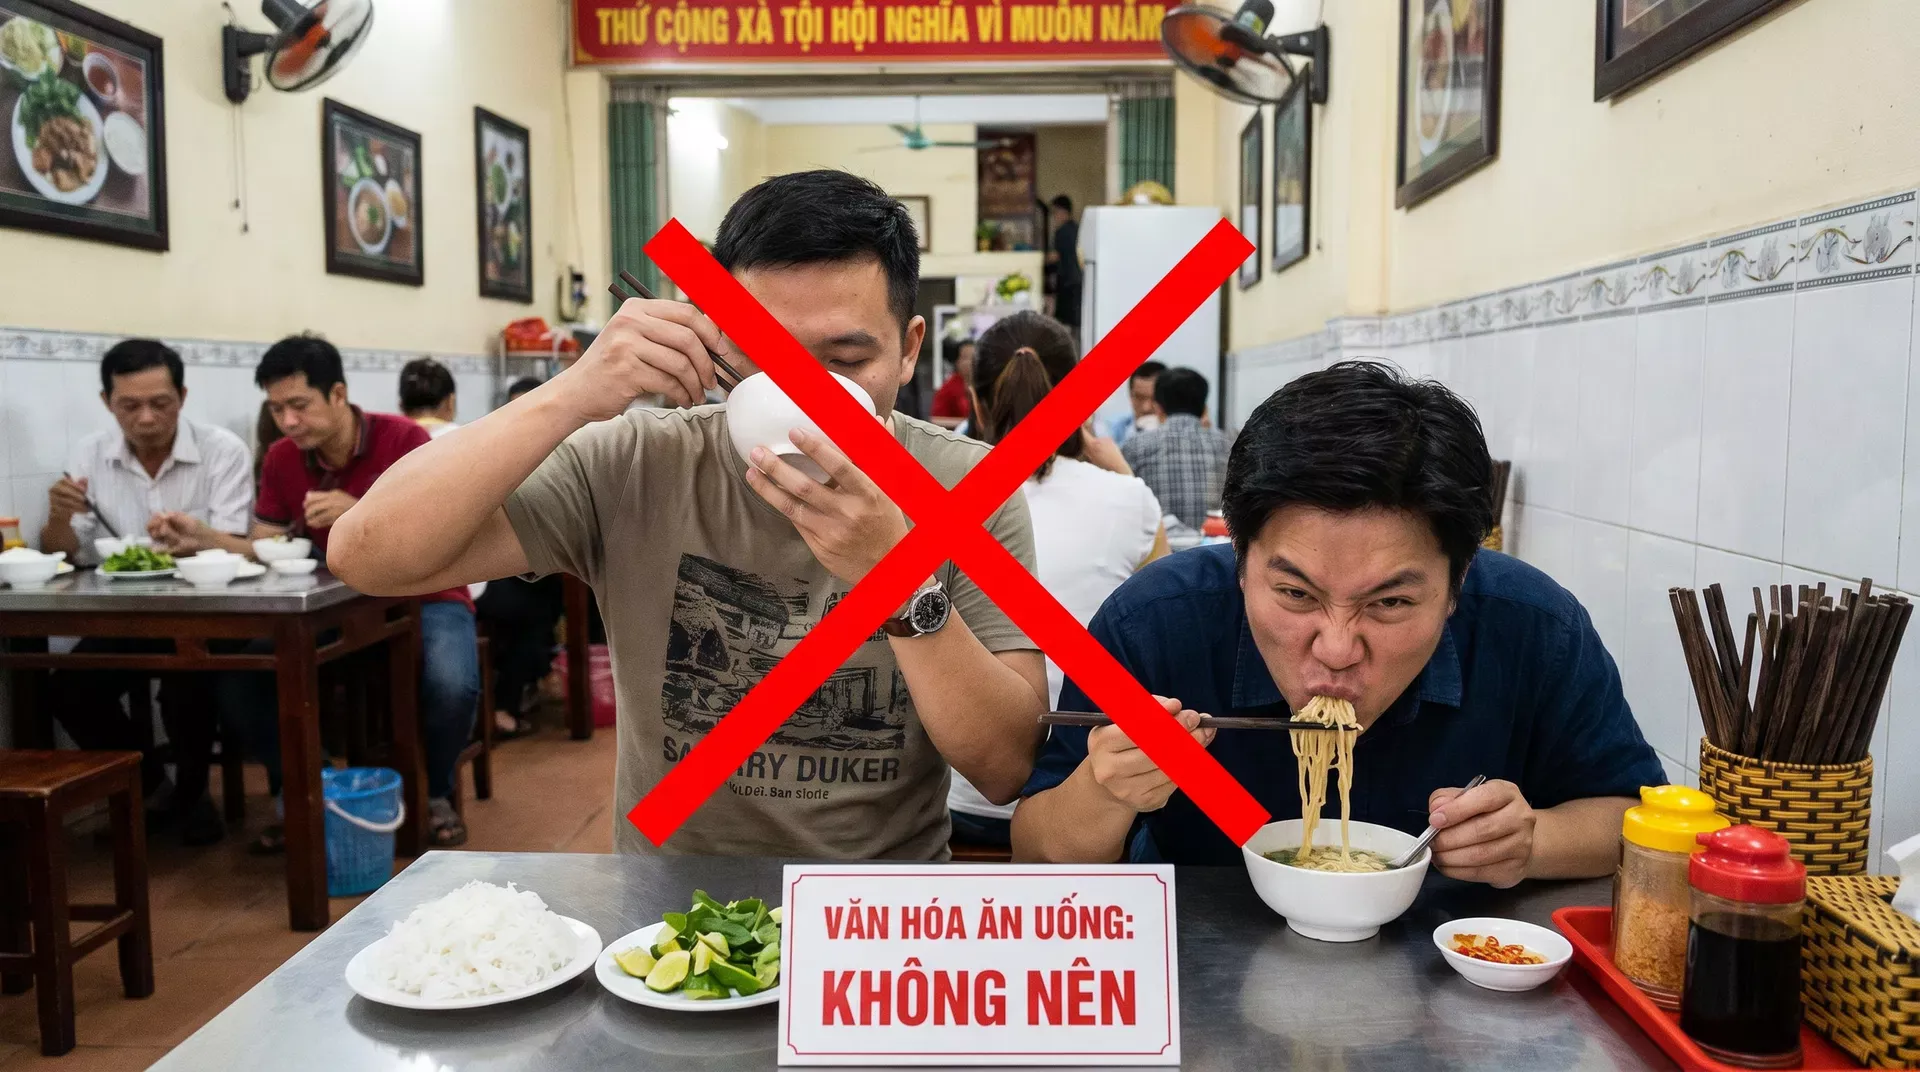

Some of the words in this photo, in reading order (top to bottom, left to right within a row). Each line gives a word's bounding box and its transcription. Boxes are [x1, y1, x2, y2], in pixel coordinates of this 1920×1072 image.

[596, 0, 652, 45] THỨ
[655, 0, 729, 52] CỘNG
[780, 0, 824, 52] TỘI
[830, 0, 877, 52] HỘI
[797, 755, 901, 784] DUKER
[824, 898, 890, 941] VĂN
[900, 897, 968, 941] HÓA
[976, 898, 1023, 941] ĂN
[1034, 892, 1135, 941] UỐNG:
[821, 956, 1007, 1028] KHÔNG
[1026, 956, 1137, 1028] NÊN
